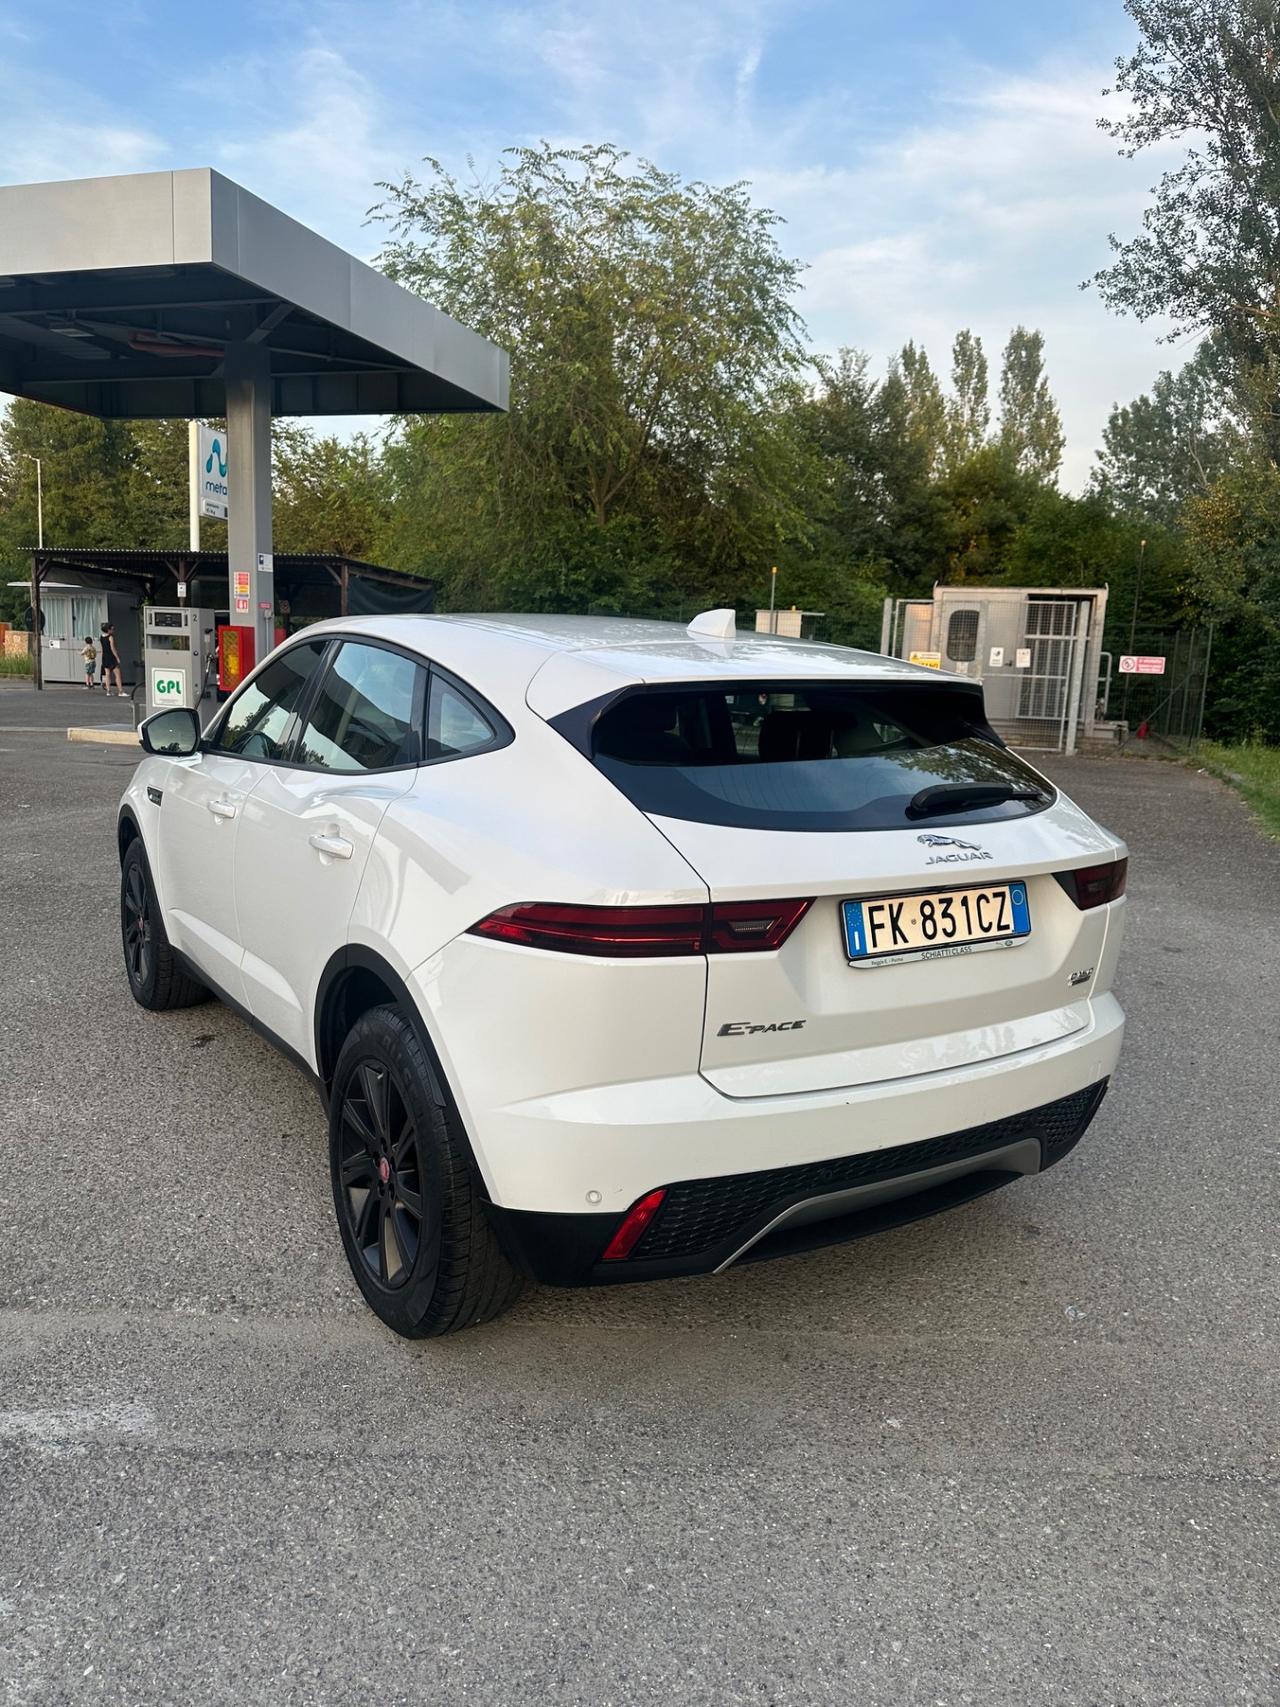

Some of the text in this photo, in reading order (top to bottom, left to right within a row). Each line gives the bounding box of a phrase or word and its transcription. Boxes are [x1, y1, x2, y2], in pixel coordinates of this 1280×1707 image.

[156, 680, 182, 695] GPL
[925, 851, 993, 865] JAGUAR
[868, 891, 1011, 948] FK 831CZ
[921, 946, 973, 960] SCHIATTI CLASS
